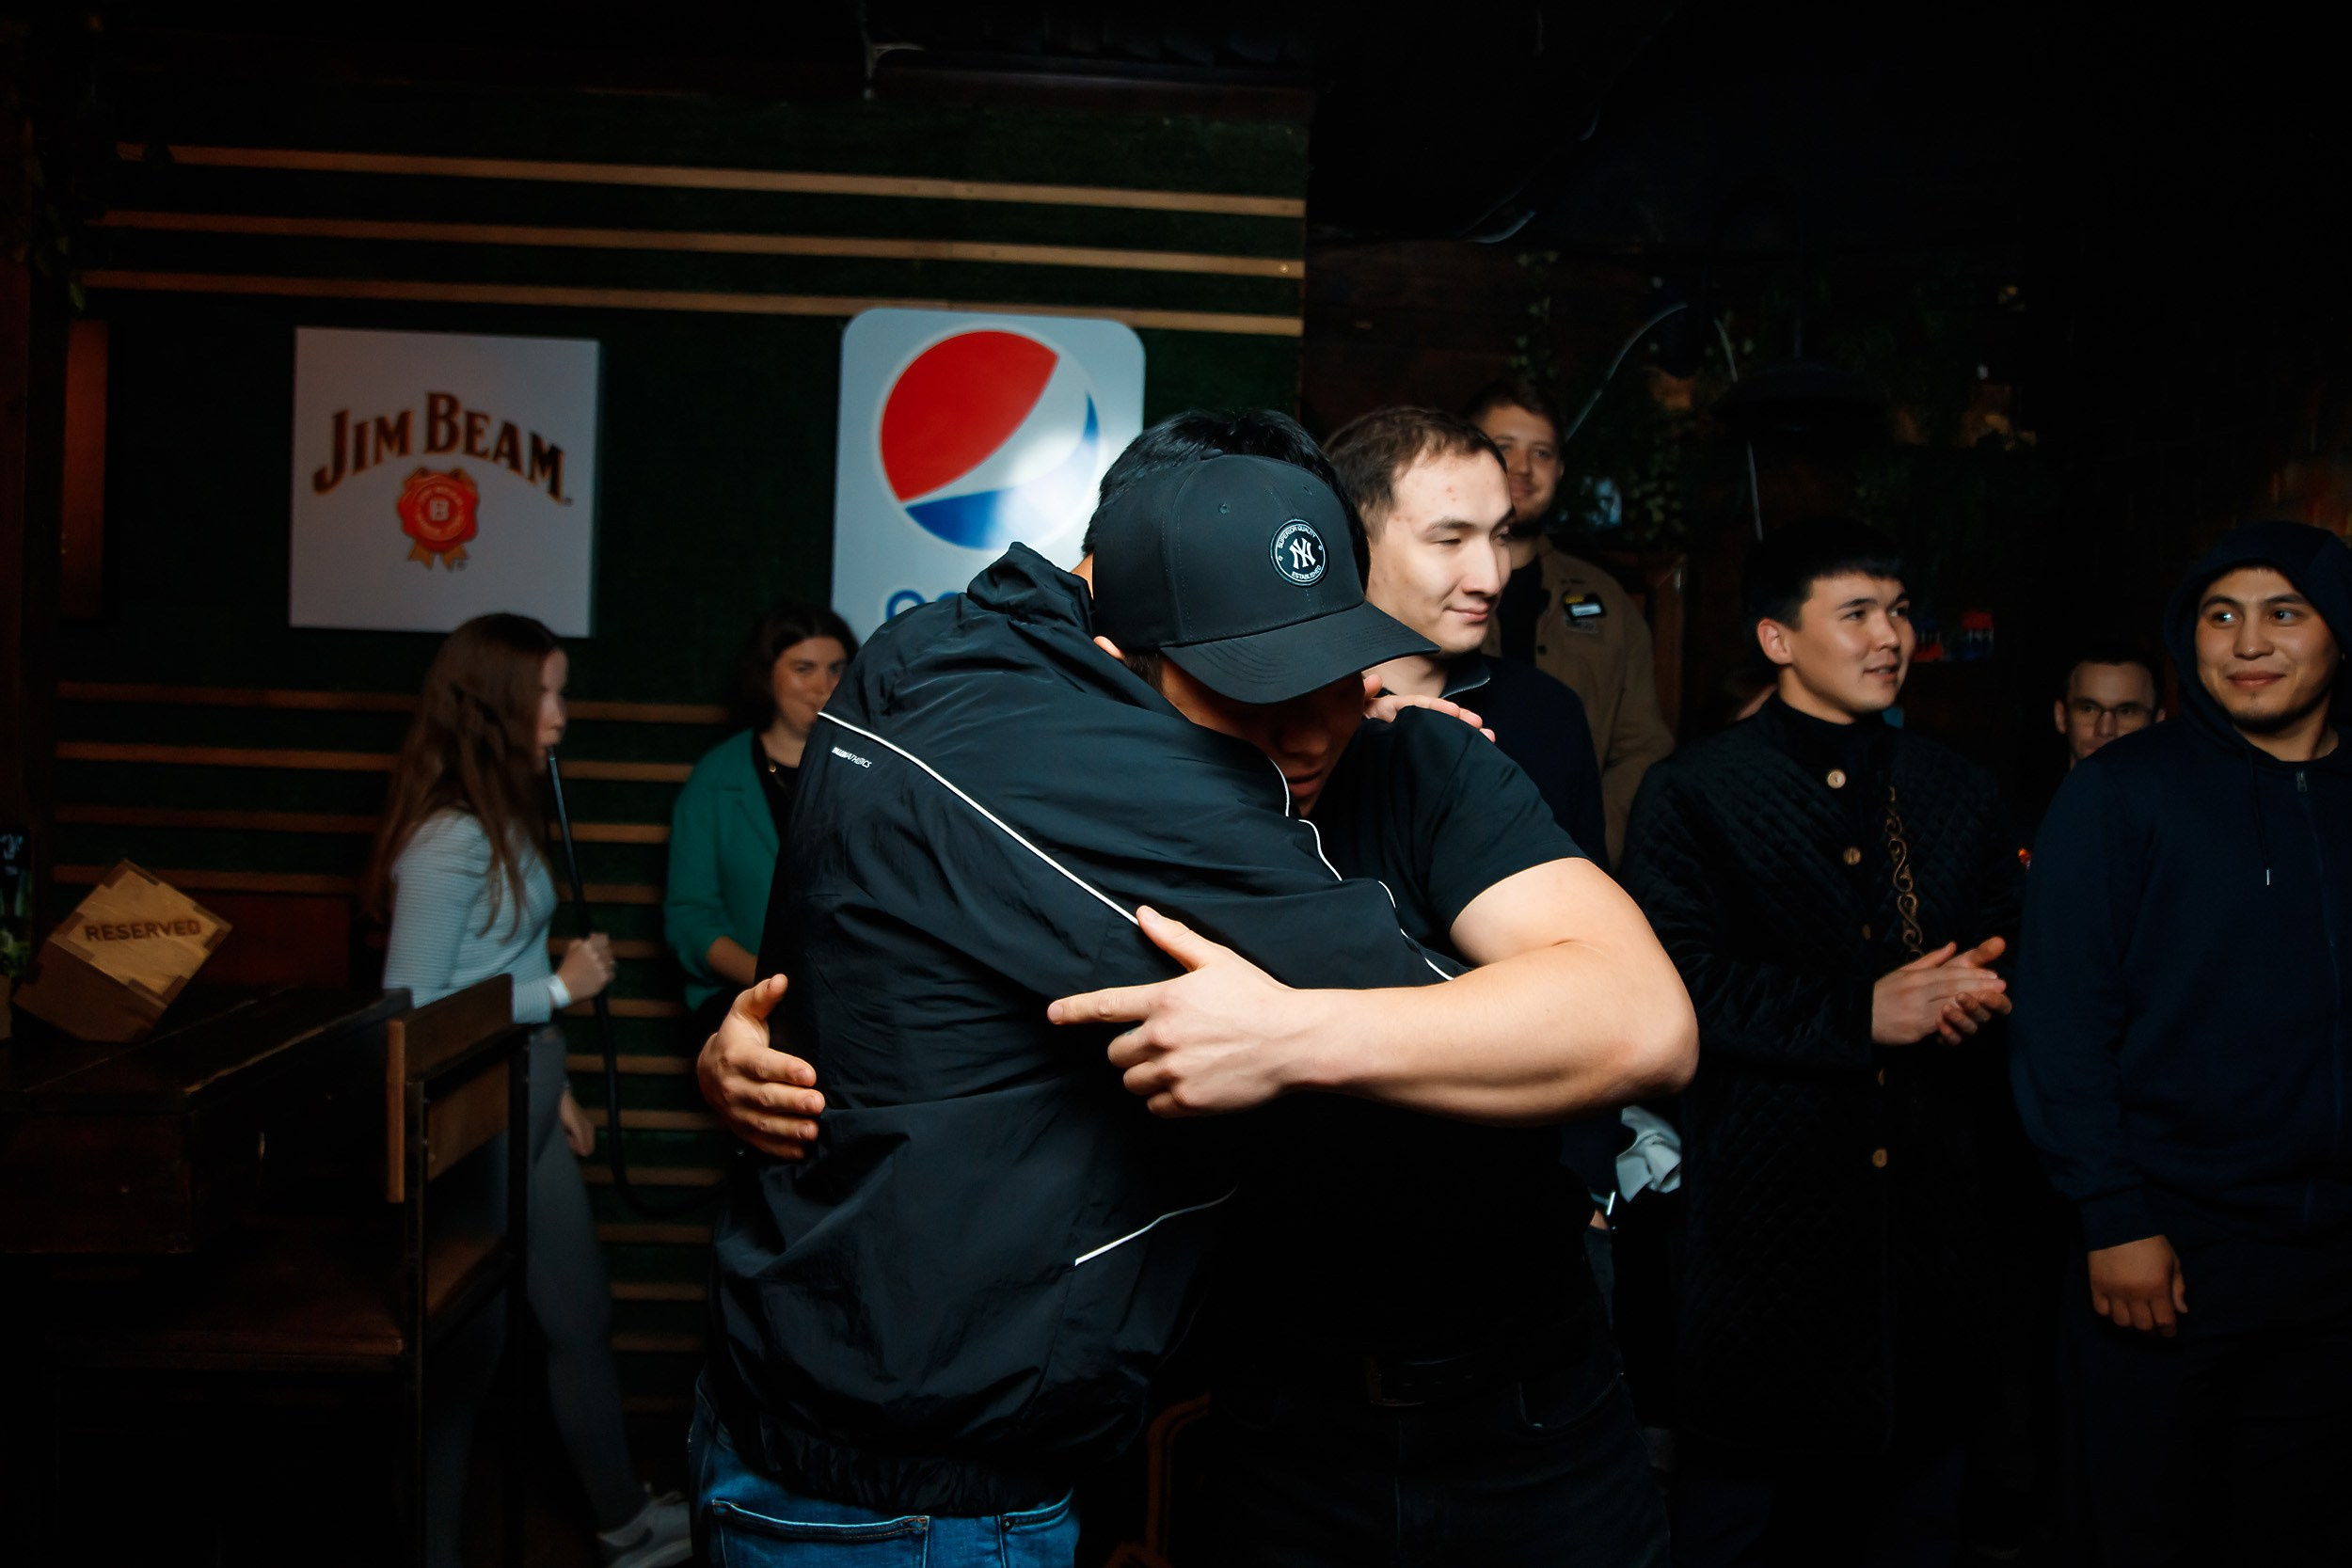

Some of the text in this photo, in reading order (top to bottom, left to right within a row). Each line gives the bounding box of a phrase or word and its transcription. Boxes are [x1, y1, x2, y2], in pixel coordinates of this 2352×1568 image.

[313, 391, 564, 504] JIM BEAM
[1278, 525, 1316, 548] SUPERIOR QUALITY
[1289, 537, 1316, 569] NY
[86, 920, 201, 942] RESERVED
